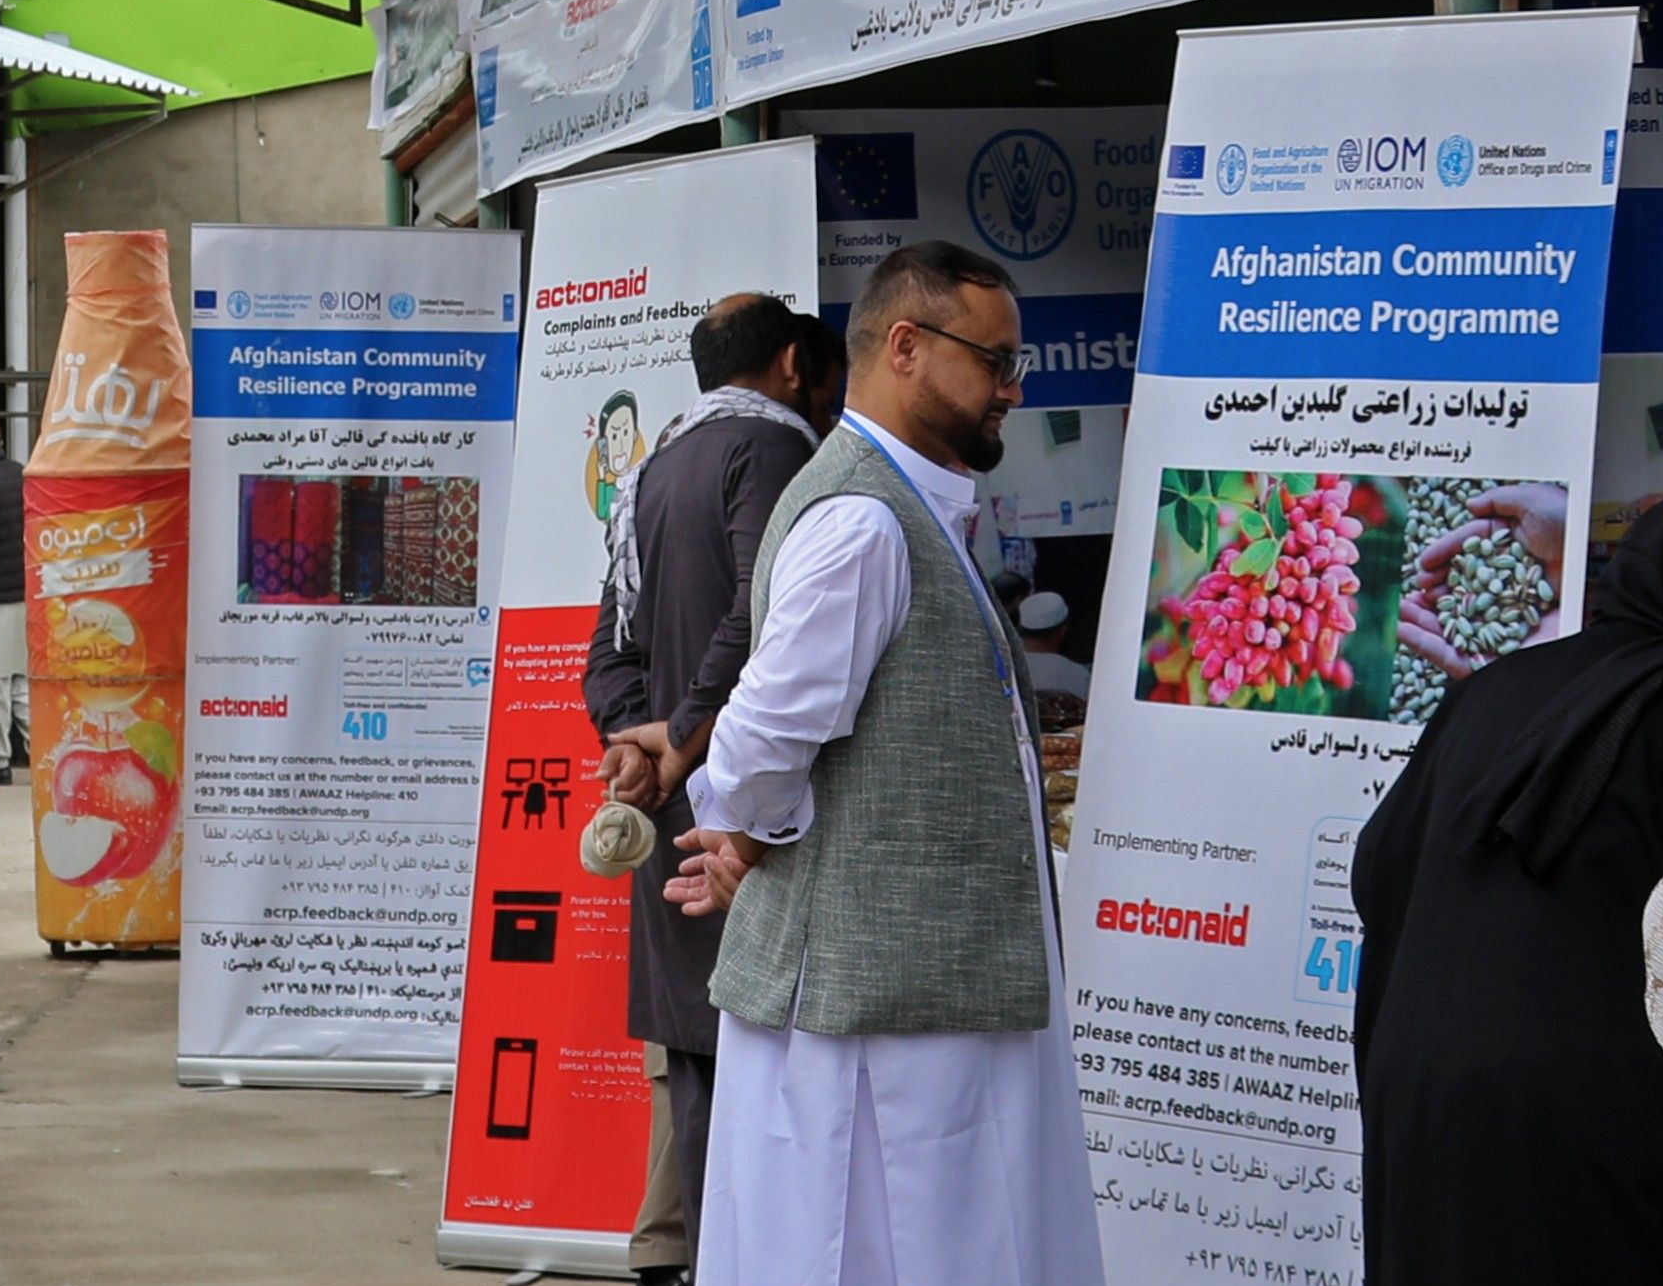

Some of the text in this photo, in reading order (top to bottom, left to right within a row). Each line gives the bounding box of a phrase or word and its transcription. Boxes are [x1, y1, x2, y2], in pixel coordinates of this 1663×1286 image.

[851, 5, 887, 51] بادغیس
[889, 0, 923, 36] ولایت
[1211, 242, 1576, 284] Afghanistan Community
[341, 291, 381, 311] IOM
[536, 267, 647, 310] actionaid
[544, 307, 643, 336] Complaints and
[1219, 301, 1560, 341] Resilience Programme
[229, 346, 486, 371] Afghanistan Community
[238, 376, 476, 400] Resilience Programme
[342, 711, 387, 741] 410
[1124, 1094, 1337, 1144] acrp.feedback@undp.org
